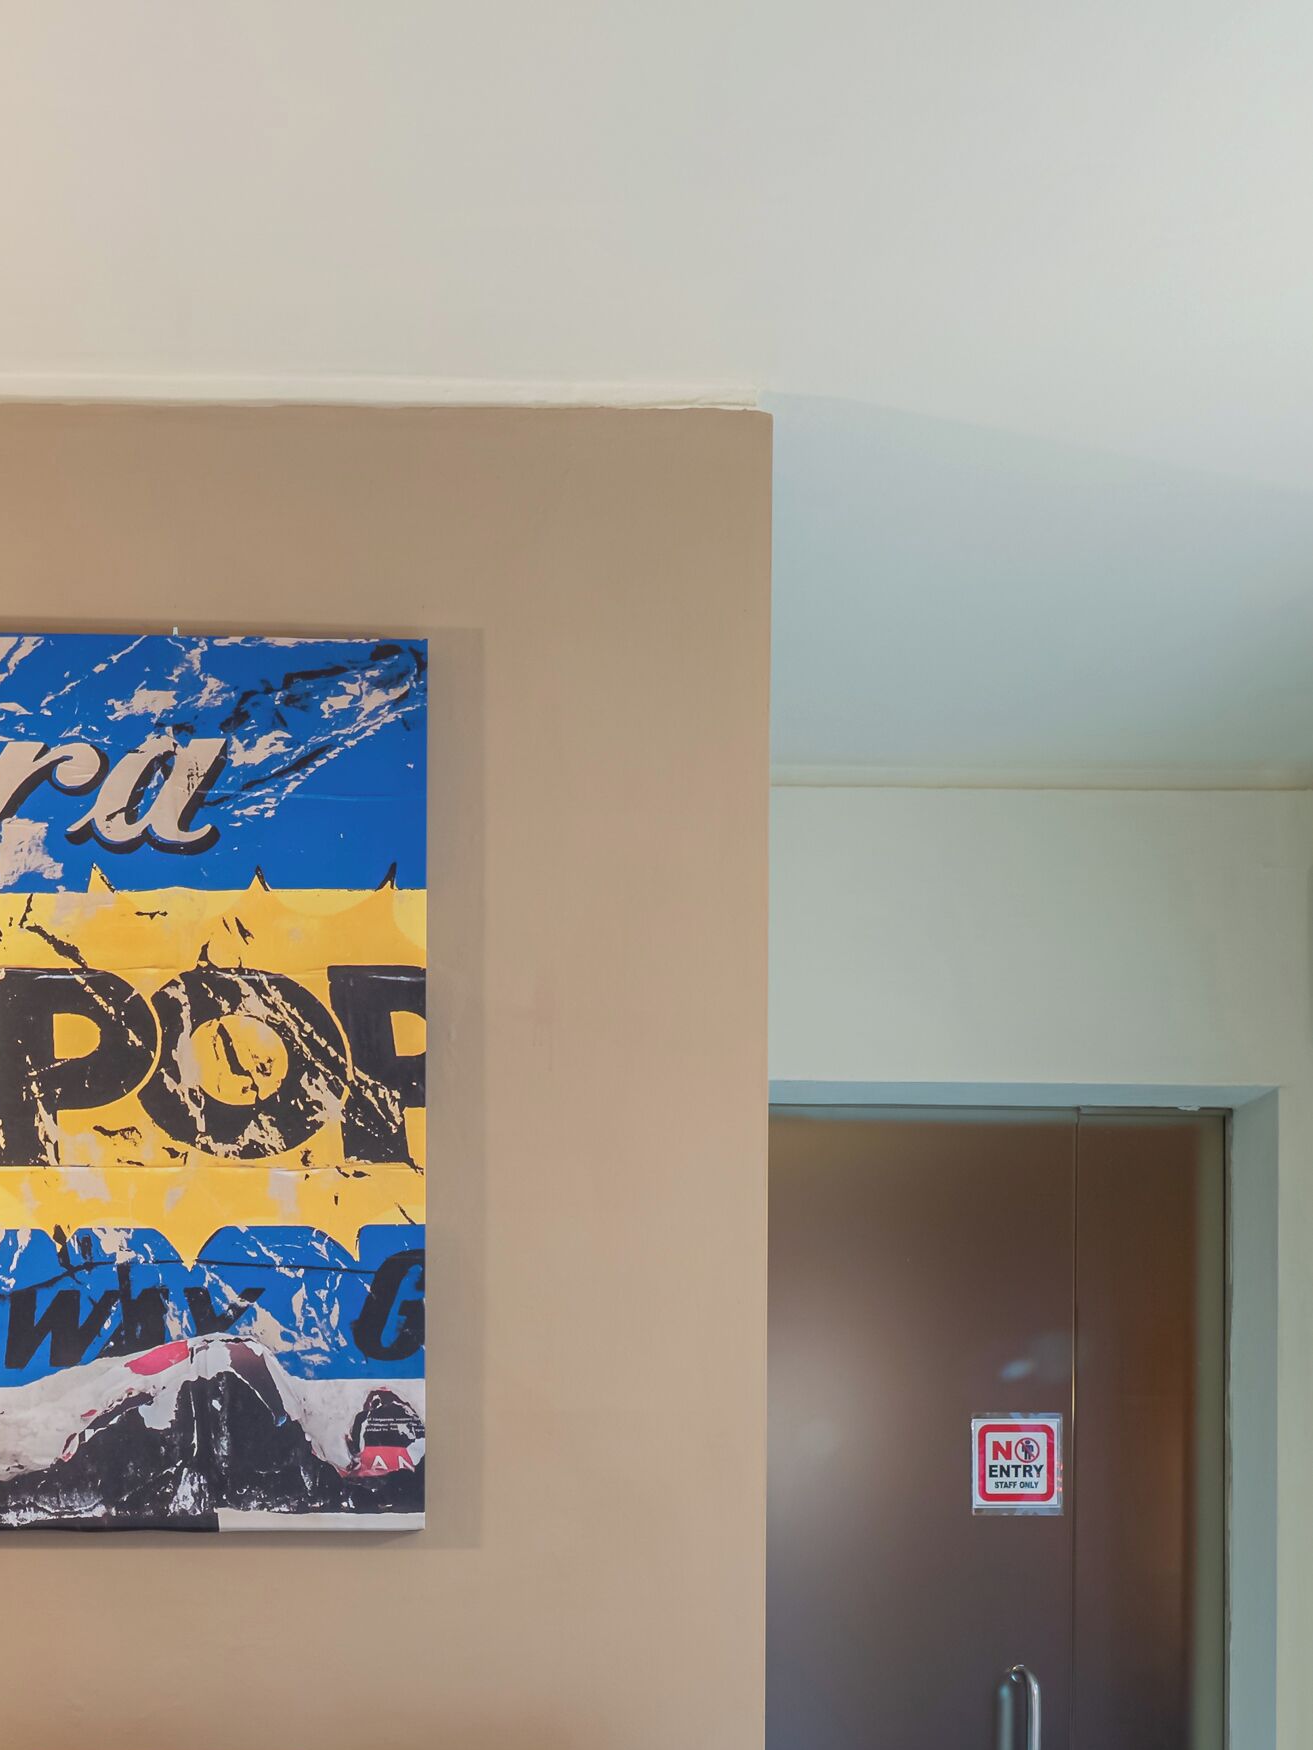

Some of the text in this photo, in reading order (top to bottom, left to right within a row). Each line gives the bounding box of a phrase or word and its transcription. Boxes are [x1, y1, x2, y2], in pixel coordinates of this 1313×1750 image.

[989, 1464, 1044, 1478] ENTRY
[994, 1481, 1039, 1489] STAFF ONLY
